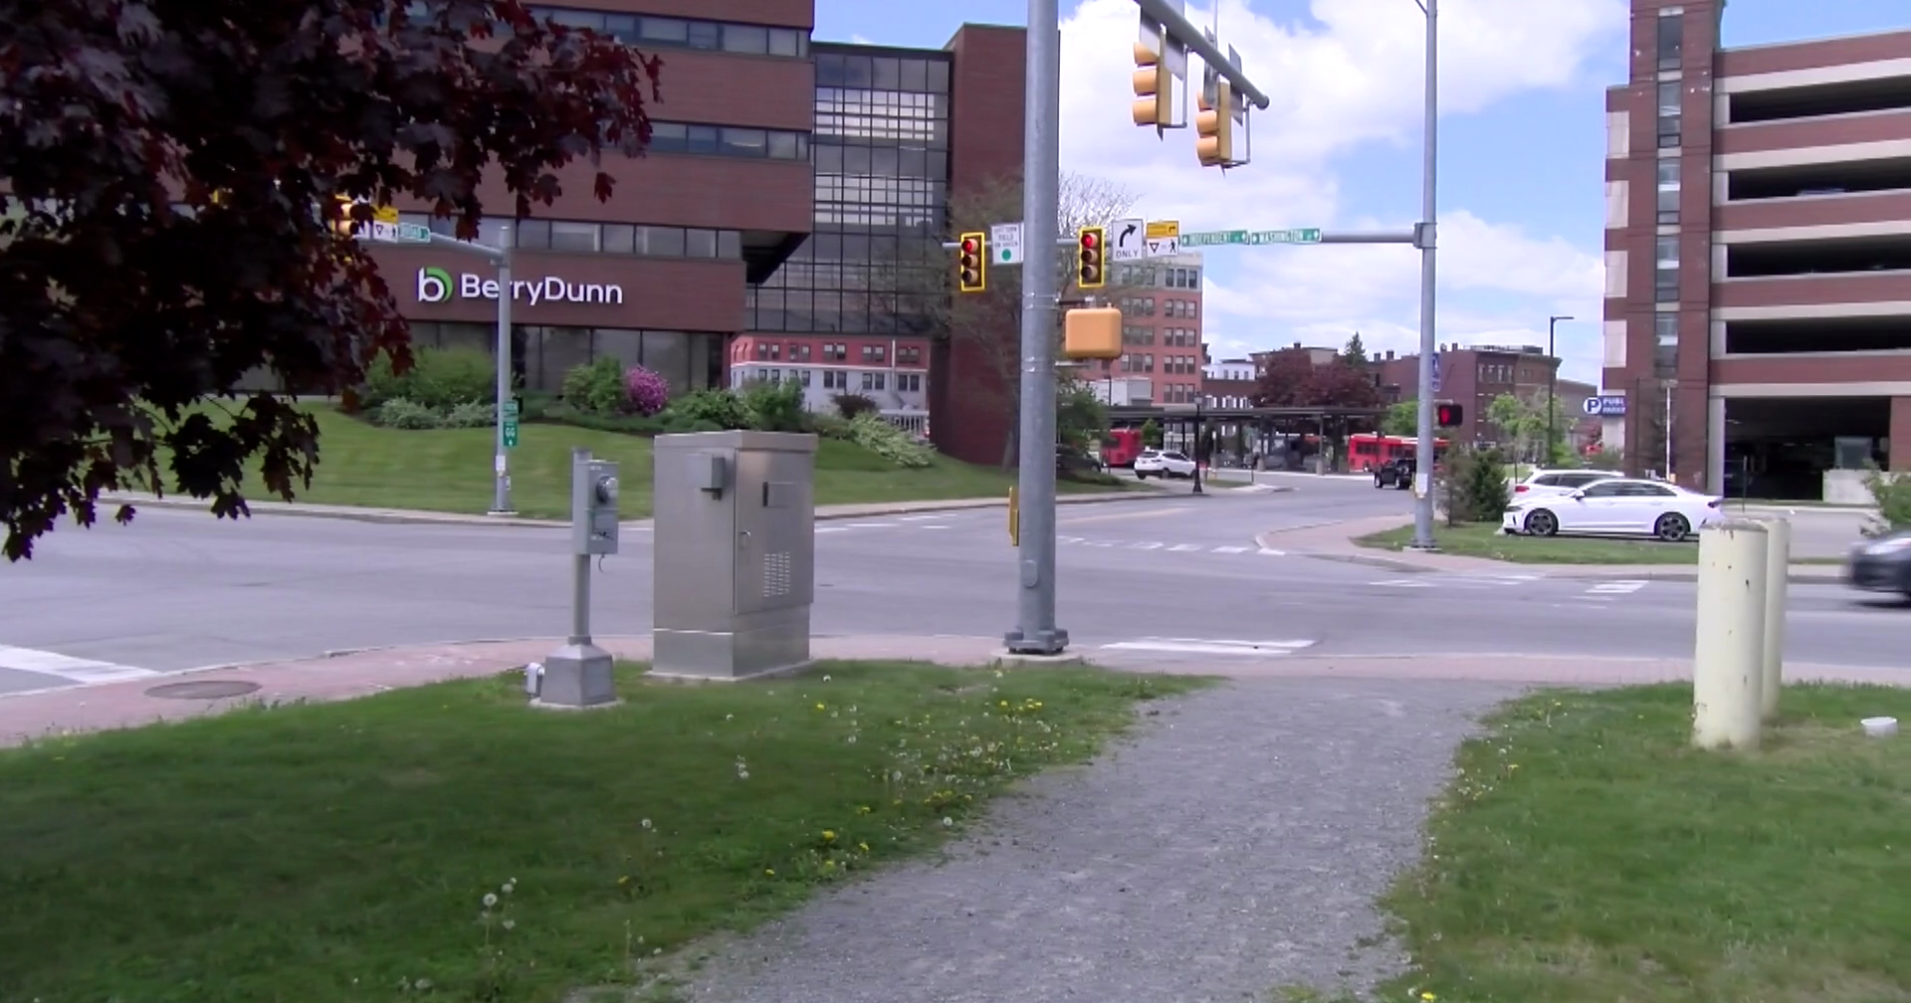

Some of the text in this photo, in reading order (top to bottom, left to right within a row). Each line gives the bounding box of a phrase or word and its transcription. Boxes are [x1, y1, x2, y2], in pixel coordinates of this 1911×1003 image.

[1259, 230, 1303, 244] WASHINGTON
[1116, 249, 1139, 259] ONLY
[461, 272, 623, 306] BeryDunn
